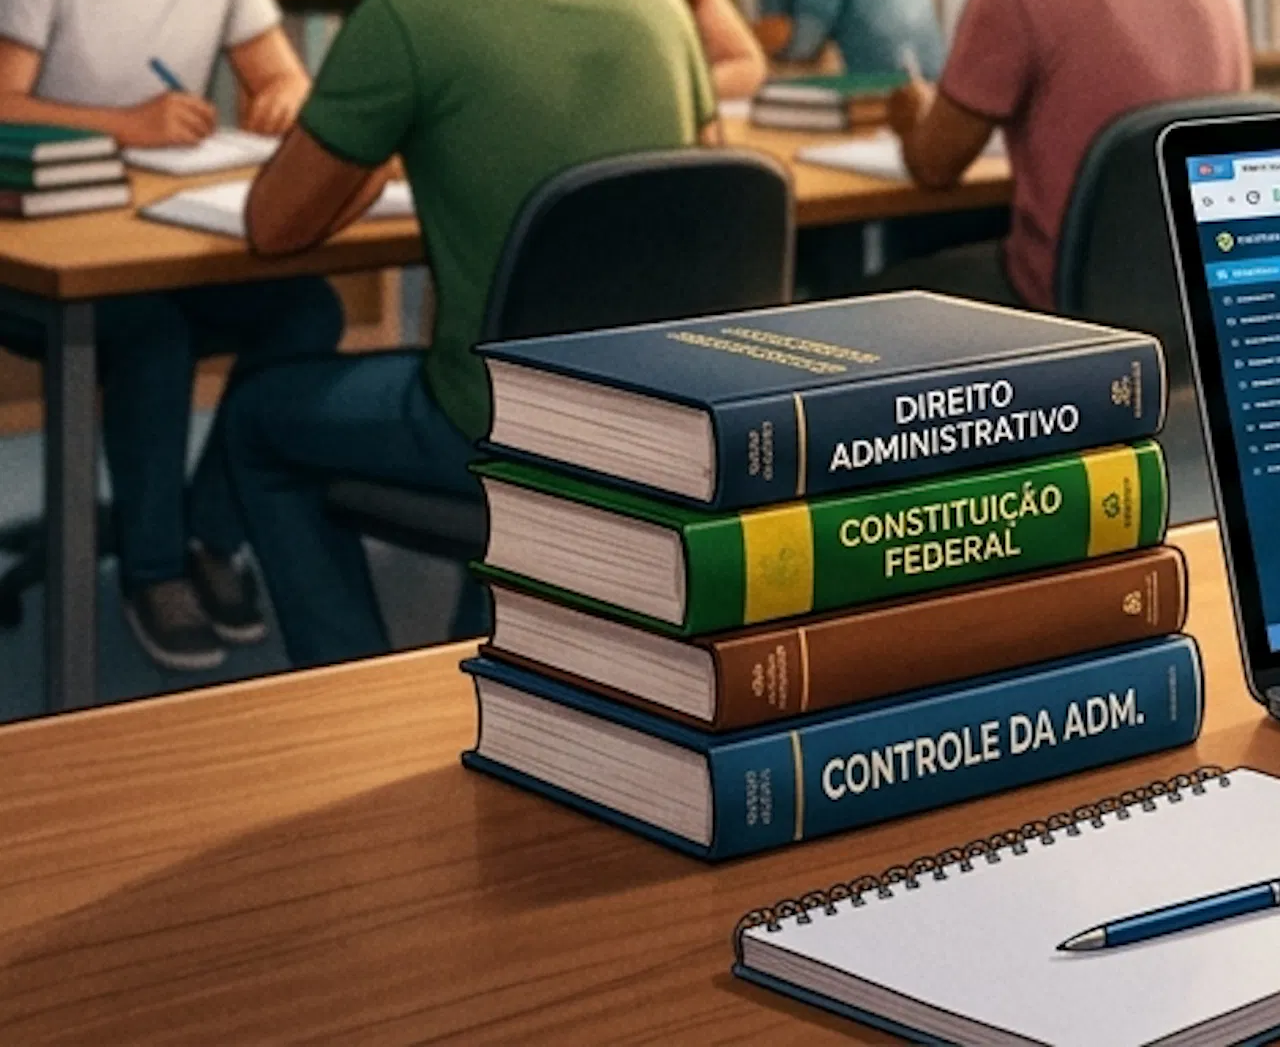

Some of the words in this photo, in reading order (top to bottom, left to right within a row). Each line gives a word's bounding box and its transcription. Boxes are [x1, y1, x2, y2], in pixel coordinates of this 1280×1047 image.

[894, 379, 1014, 425] DIREITO
[829, 404, 1080, 473] ADMINISTRATIVO
[838, 482, 1063, 548] CONSTITUIÇÃO
[883, 532, 1022, 578] FEDERAL
[821, 729, 1001, 800] CONTROLE
[1008, 710, 1057, 755] DA
[1062, 689, 1145, 742] ADM.
